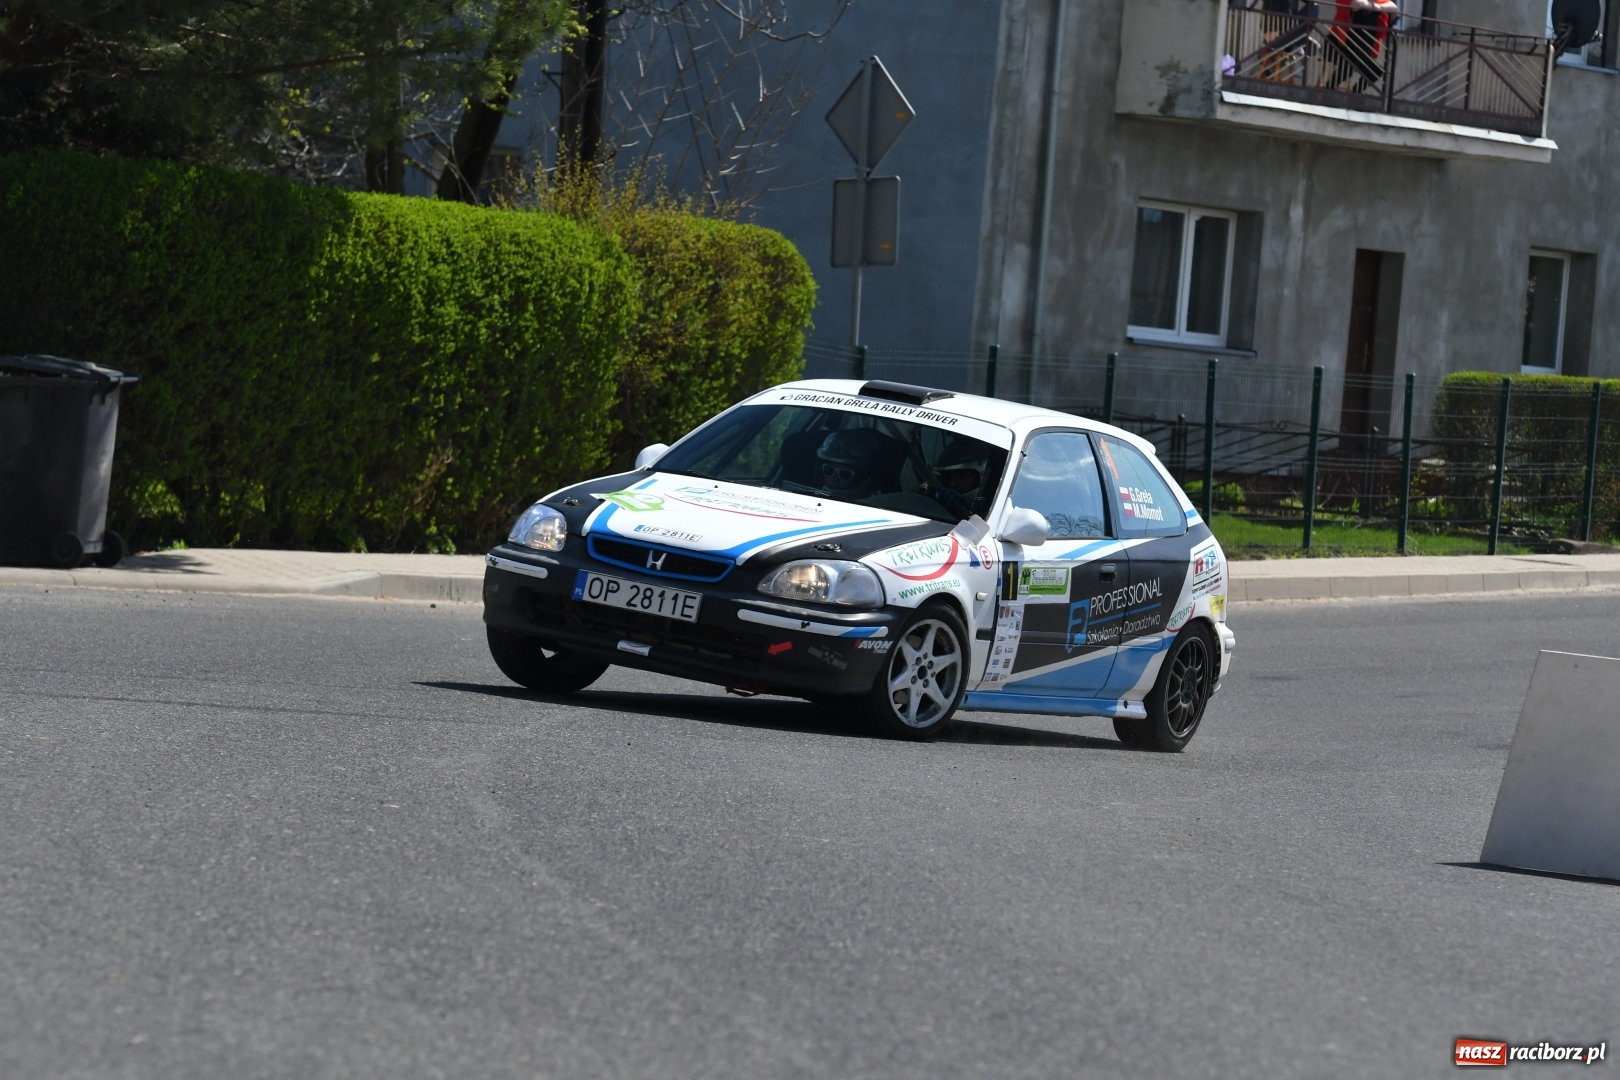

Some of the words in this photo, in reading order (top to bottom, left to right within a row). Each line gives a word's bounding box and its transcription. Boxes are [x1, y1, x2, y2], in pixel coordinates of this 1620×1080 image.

[794, 393, 844, 405] GRACJAN
[844, 398, 879, 411] GRELA
[880, 403, 918, 416] RALLY
[916, 410, 959, 426] DRIVER
[1128, 486, 1153, 504] G.Grela
[1132, 502, 1164, 521] M.Momot
[642, 525, 660, 534] OP
[661, 529, 700, 542] 2811E
[588, 577, 620, 602] OP
[625, 585, 697, 619] 2811E
[898, 578, 961, 600] www.tritrans.eu
[1089, 577, 1162, 617] PROFESSIONAL
[1087, 624, 1119, 645] Szkolenia
[1122, 614, 1161, 635] Doradztwo
[858, 640, 894, 649] AVON
